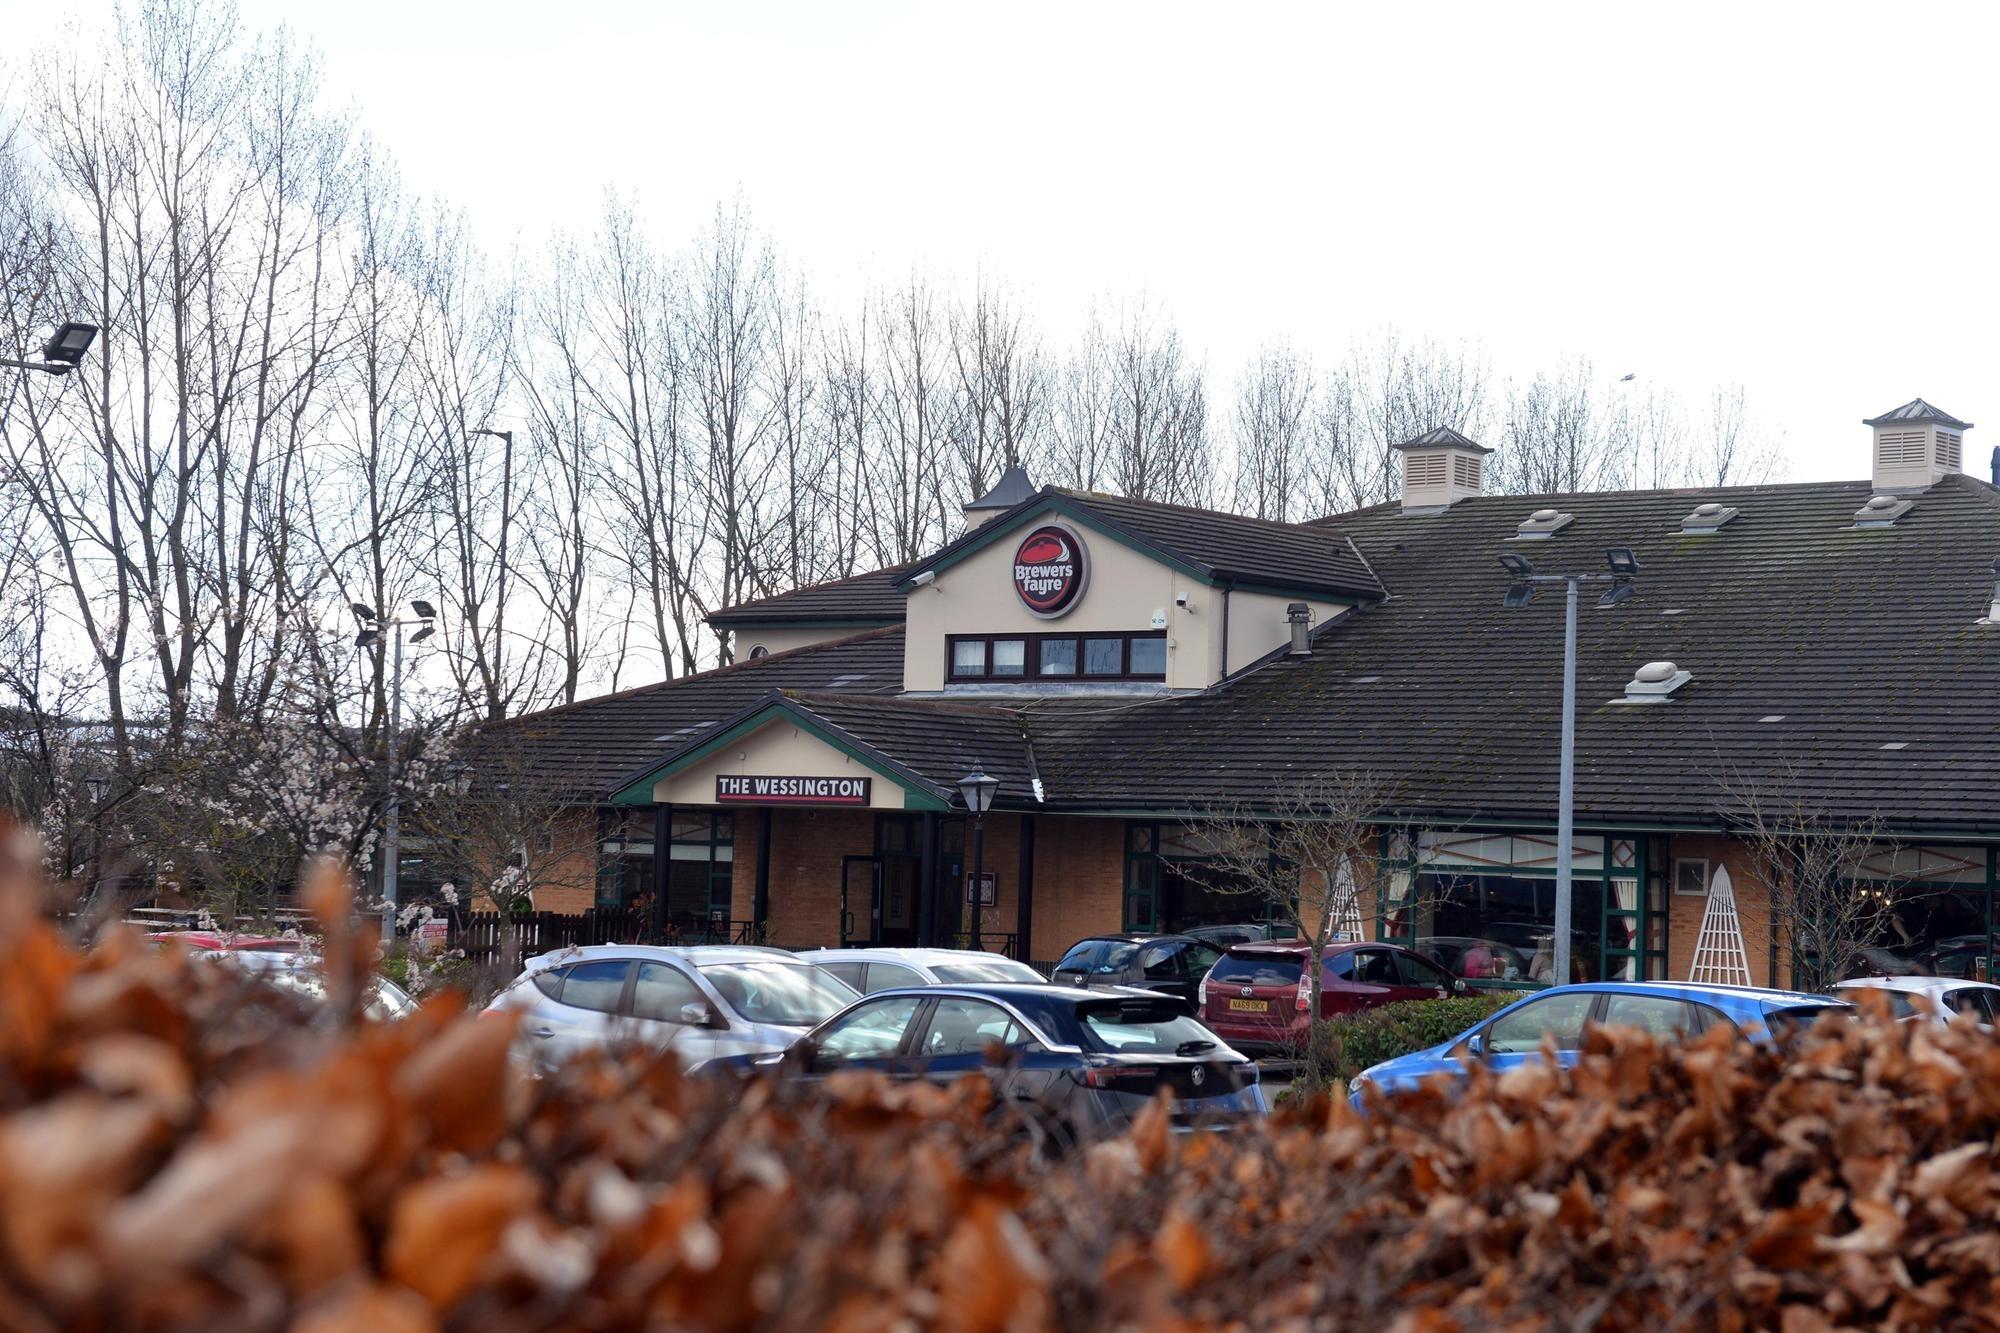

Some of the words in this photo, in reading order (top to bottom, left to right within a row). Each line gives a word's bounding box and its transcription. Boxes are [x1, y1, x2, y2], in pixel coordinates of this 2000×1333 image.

[1015, 565, 1073, 580] Brewers
[1023, 576, 1062, 595] fayre
[719, 778, 750, 794] THE
[755, 779, 864, 797] WESSINGTON
